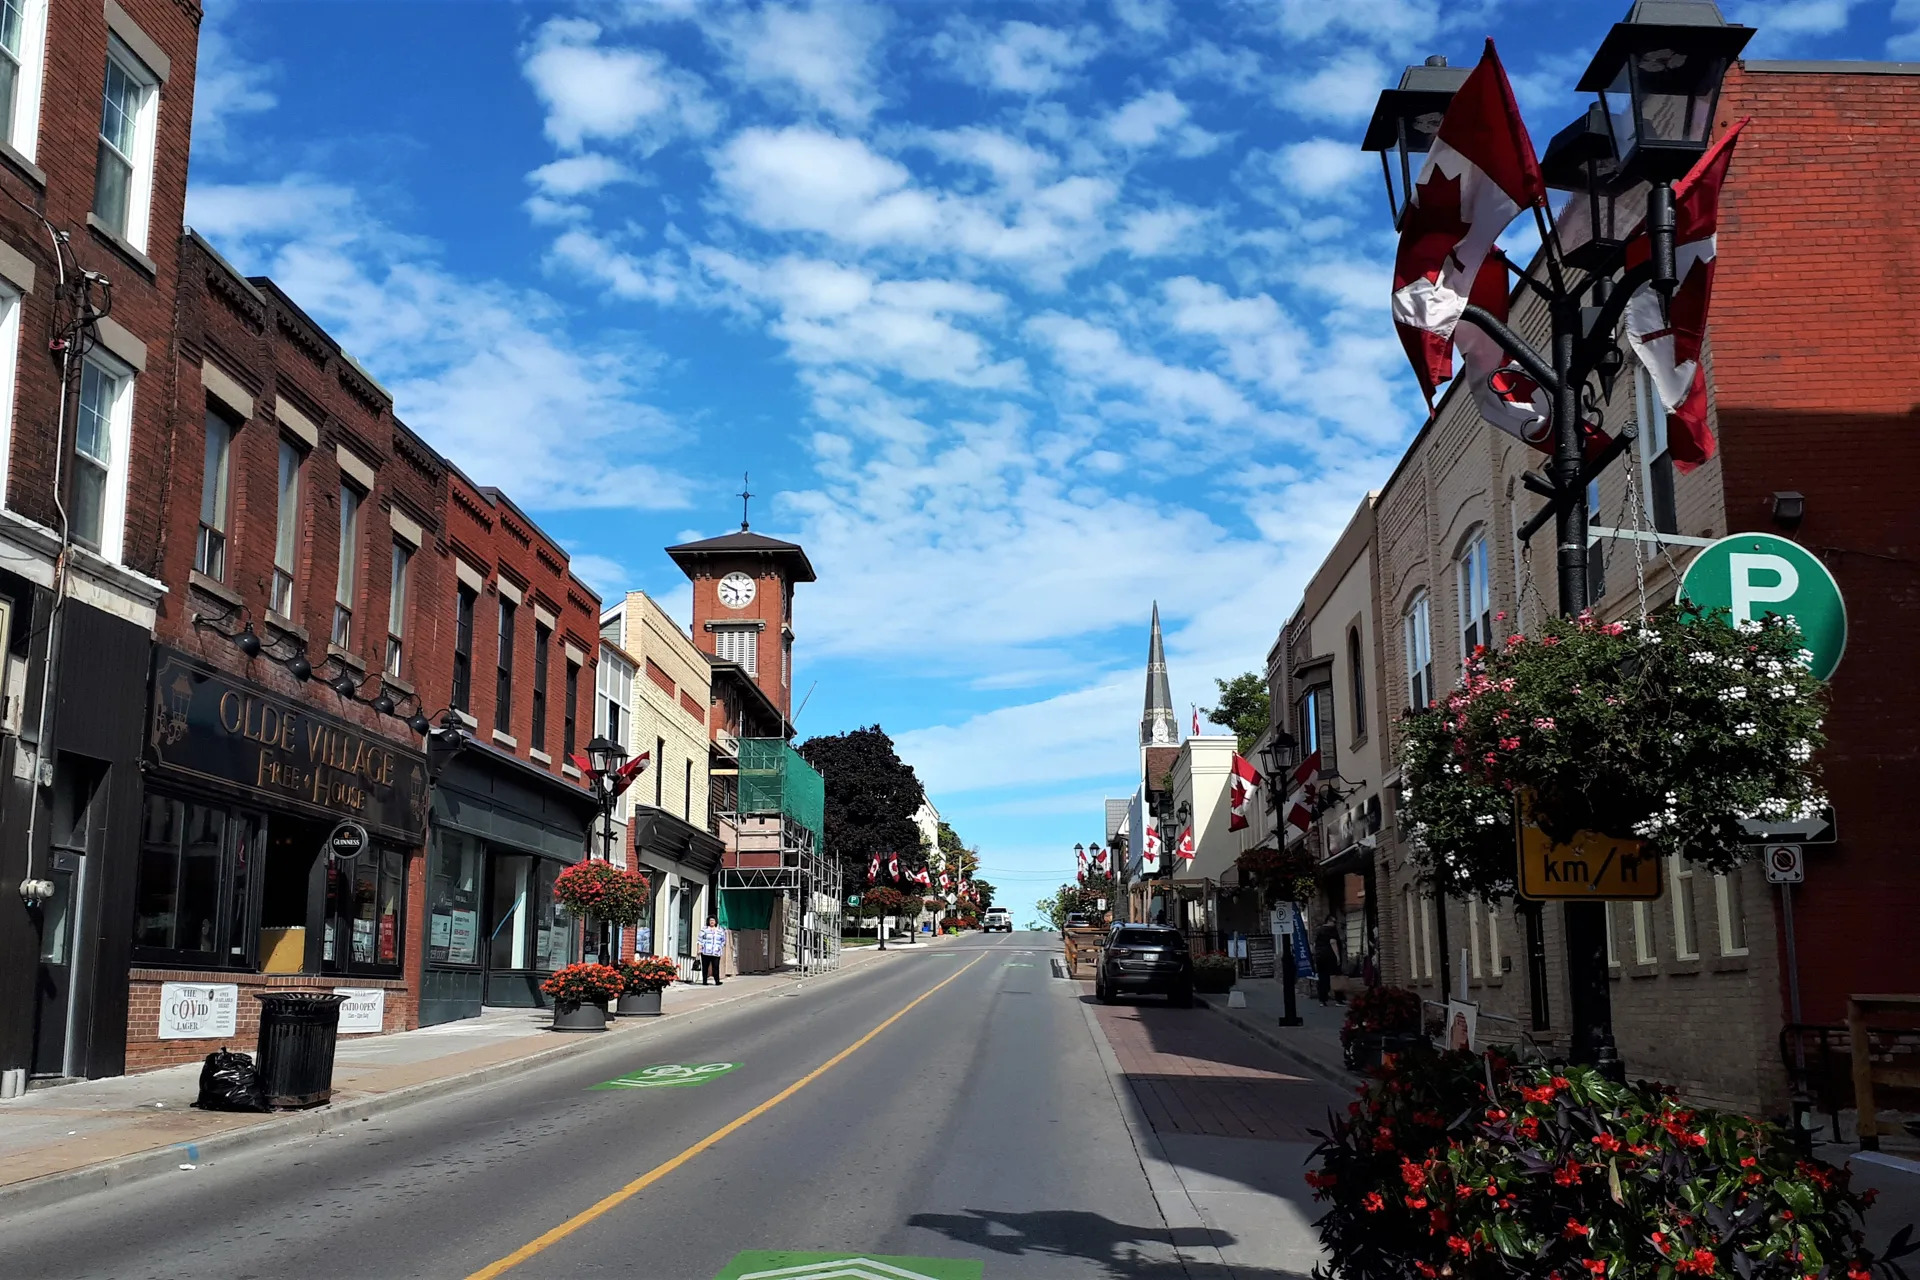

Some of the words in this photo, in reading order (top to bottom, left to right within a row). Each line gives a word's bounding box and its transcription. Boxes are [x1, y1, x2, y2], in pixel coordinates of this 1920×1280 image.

[1729, 552, 1799, 630] P
[219, 690, 297, 754] OLDE
[304, 719, 396, 788] VILLAGE
[1278, 910, 1284, 918] P
[183, 989, 197, 998] THE
[341, 1002, 358, 1010] PATIO
[177, 1022, 199, 1031] LAGER
